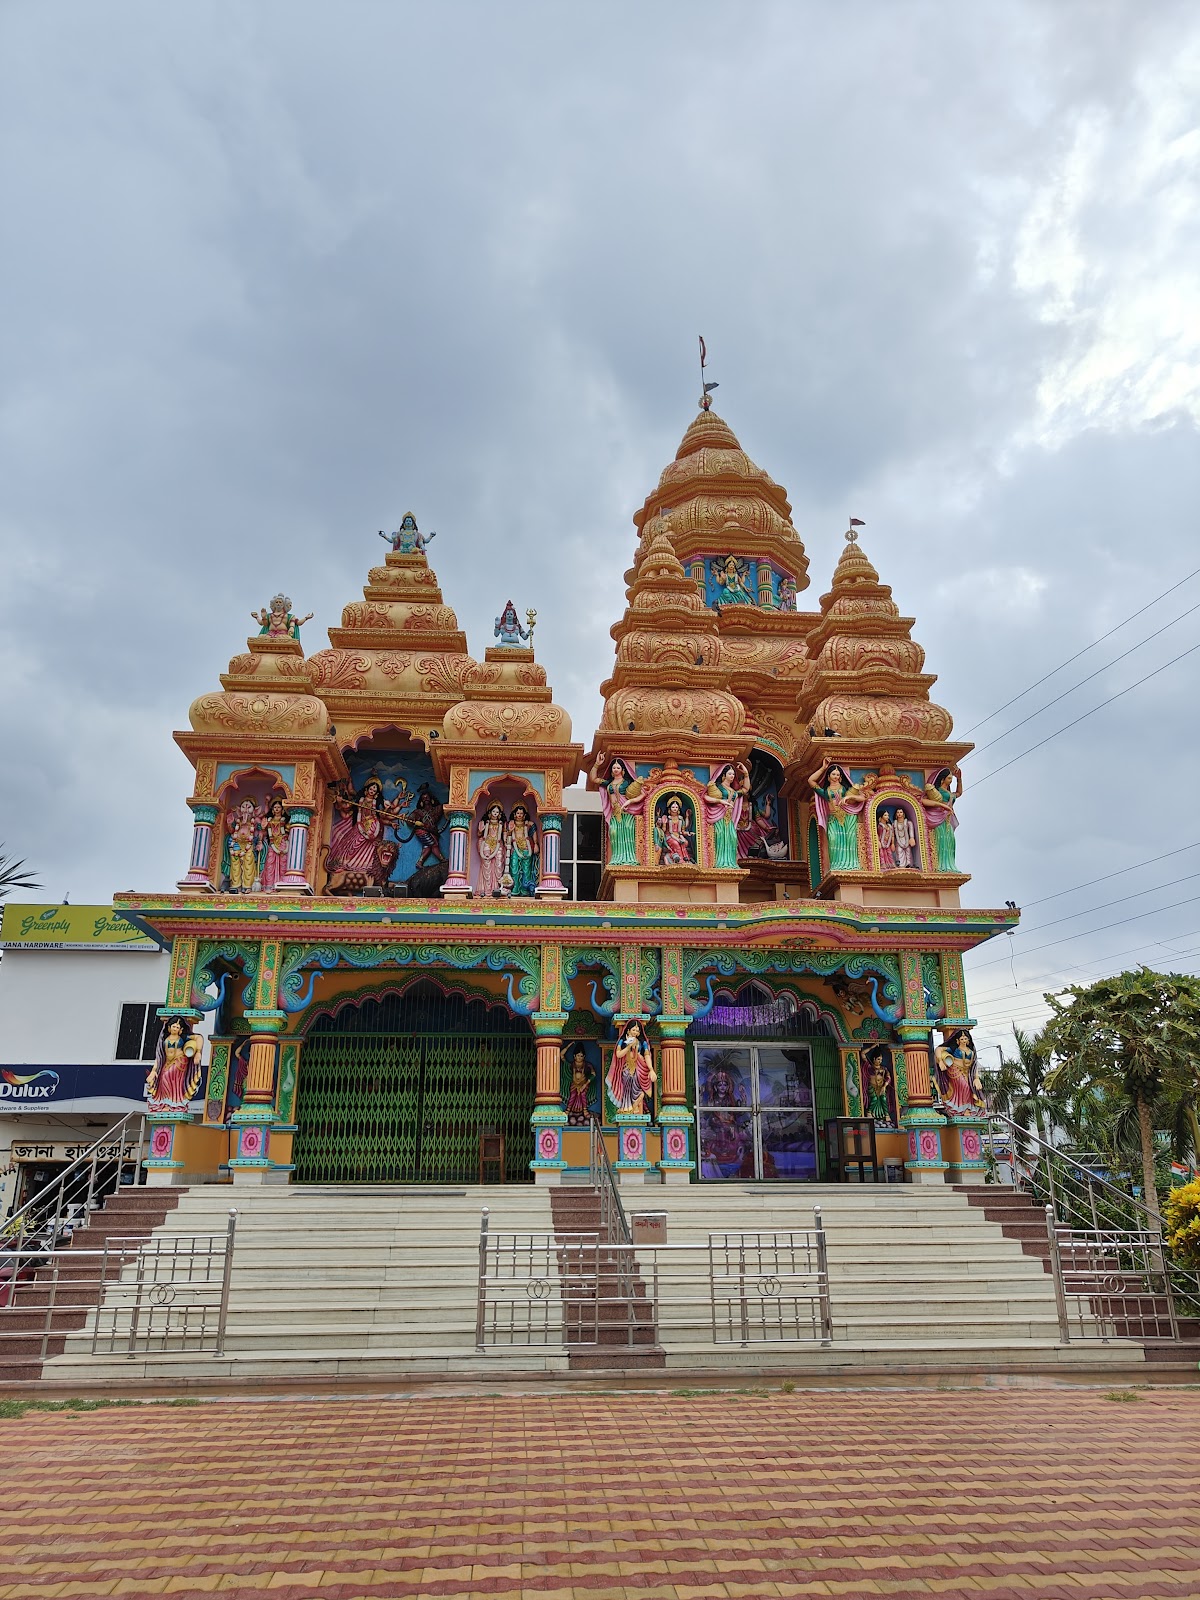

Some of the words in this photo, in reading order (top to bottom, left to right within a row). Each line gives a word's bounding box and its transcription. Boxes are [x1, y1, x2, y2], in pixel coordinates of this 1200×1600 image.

[20, 916, 71, 936] Greenply
[0, 1083, 50, 1097] Dulux
[15, 1144, 55, 1158] জানা
